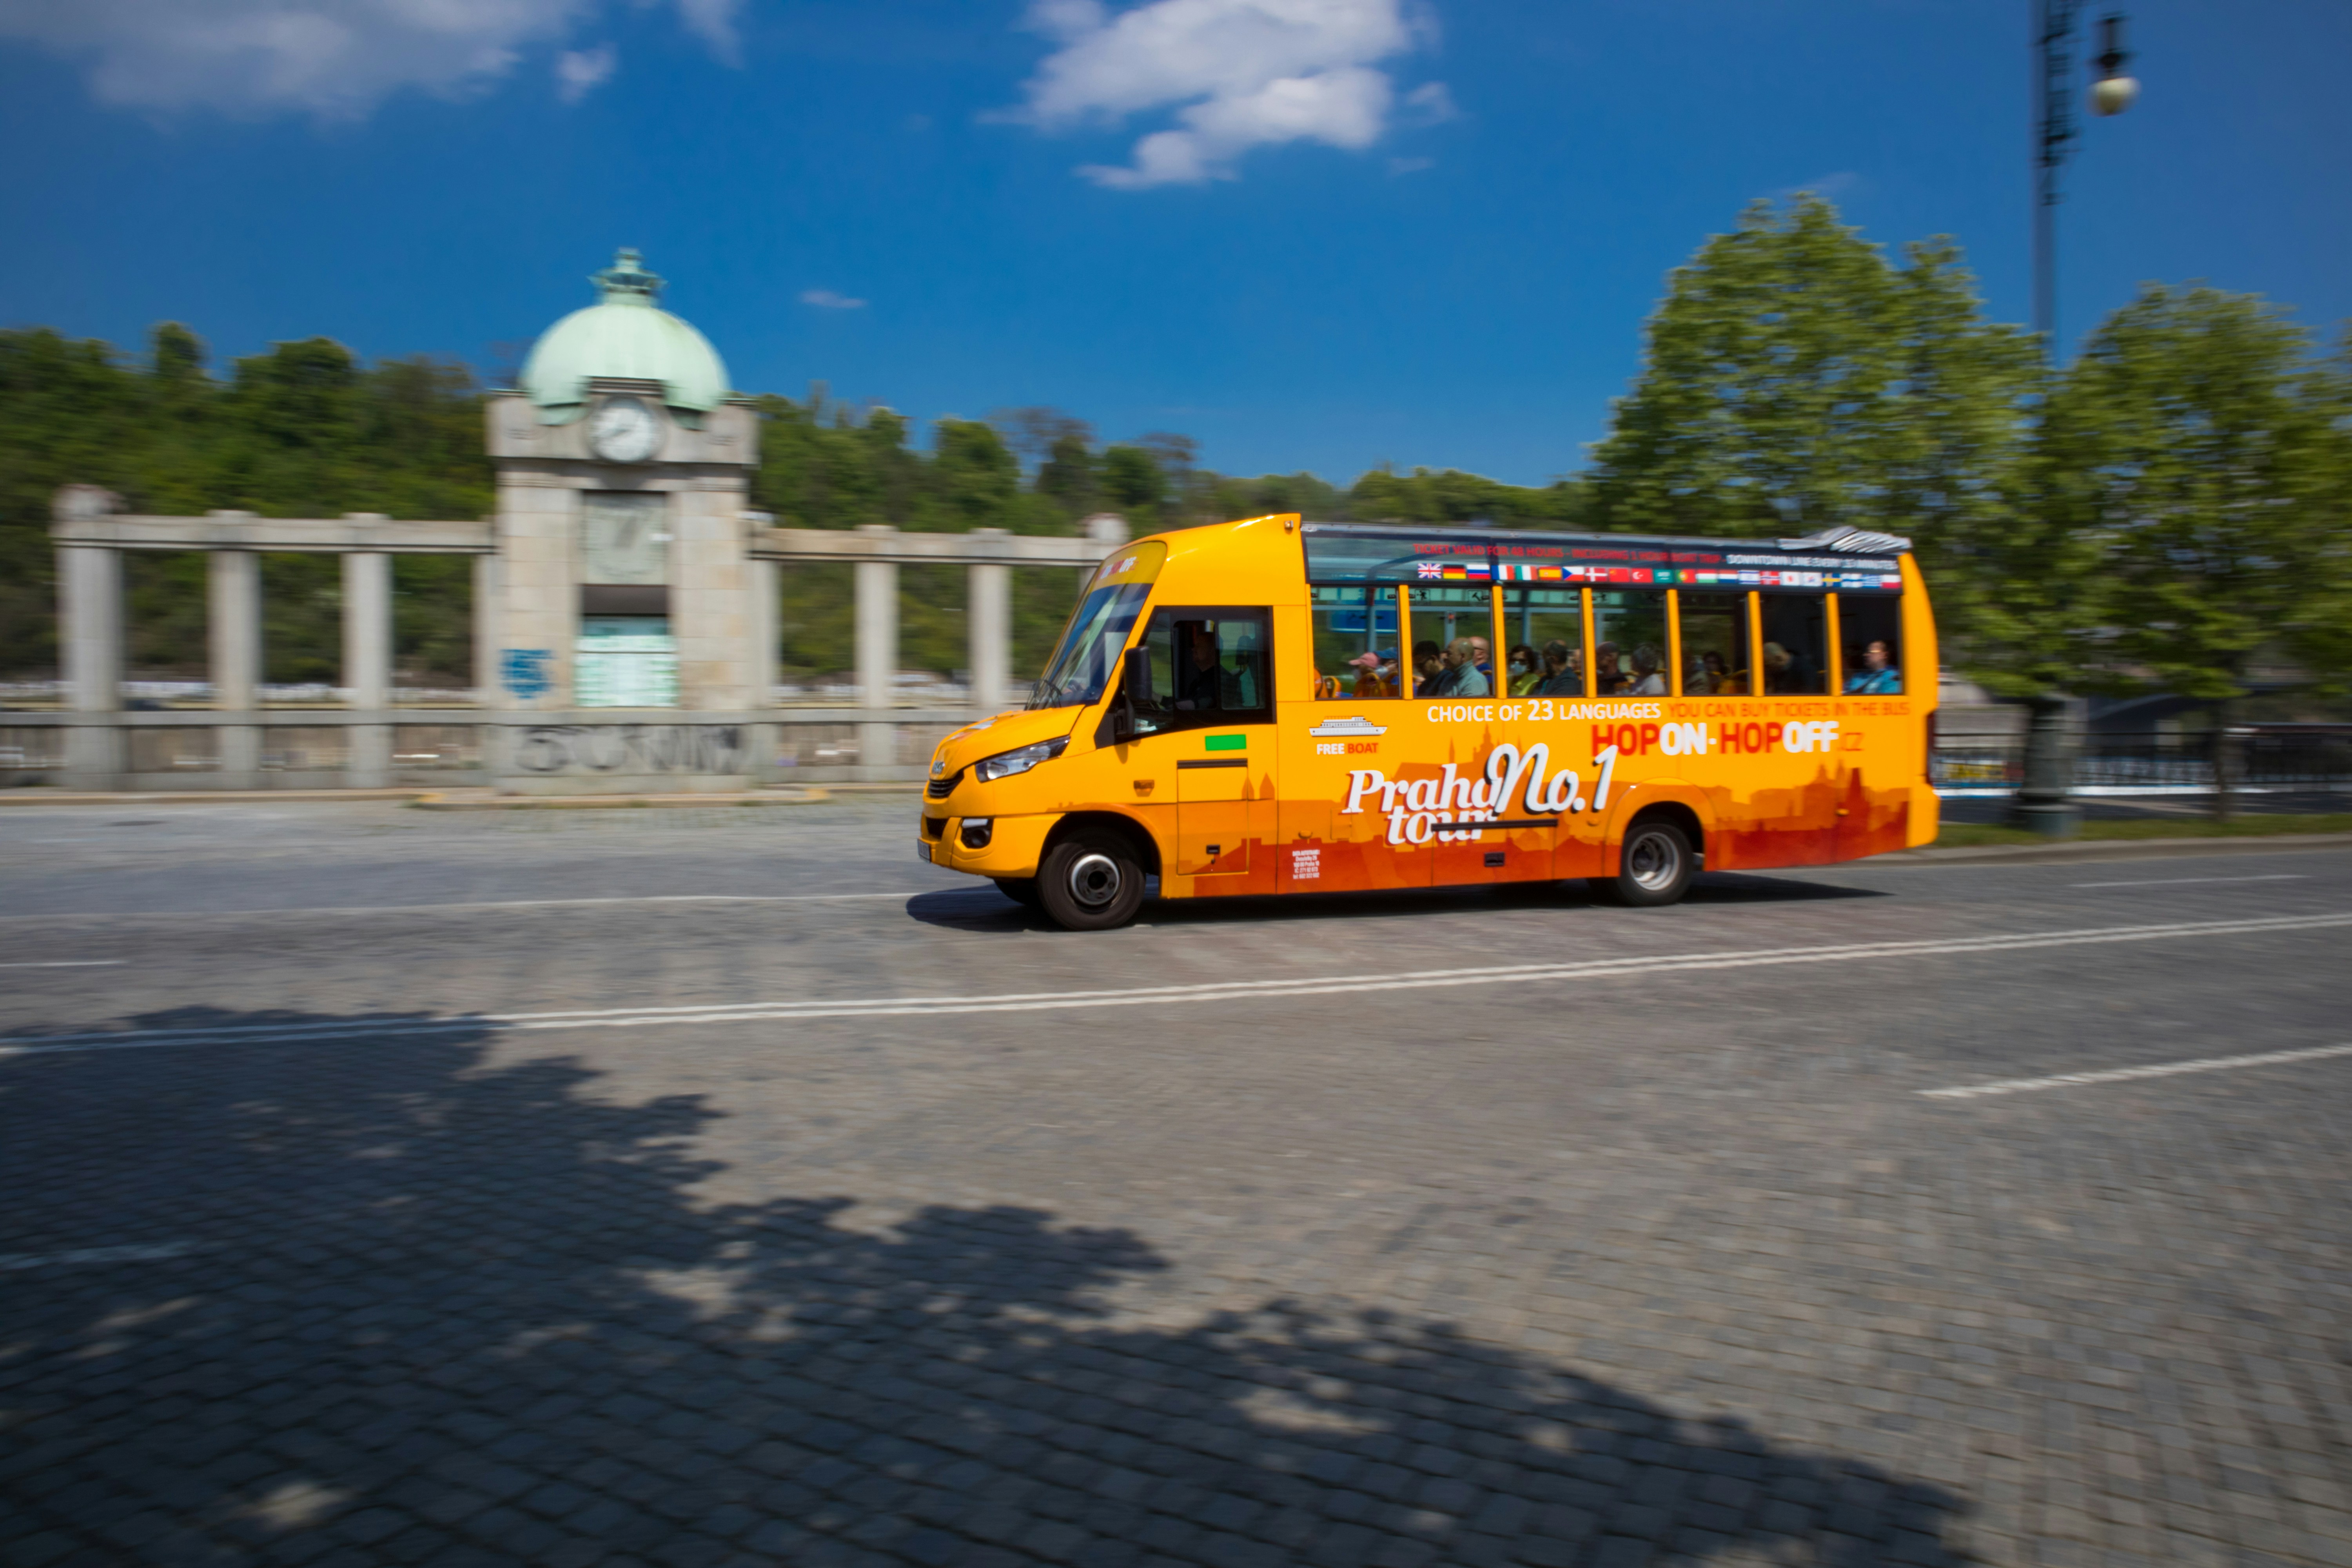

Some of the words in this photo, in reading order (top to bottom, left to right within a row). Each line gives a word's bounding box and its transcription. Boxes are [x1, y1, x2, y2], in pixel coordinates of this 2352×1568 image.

[1413, 543, 1450, 555] TICKET
[1452, 544, 1485, 555] VALID
[1486, 546, 1508, 556] FOR
[1526, 547, 1564, 558] HOURS
[1427, 705, 1494, 722] CHOICE
[1499, 704, 1523, 722] OF
[1527, 699, 1554, 721] 23
[1559, 702, 1662, 720] LANGUAGES
[1668, 703, 1700, 717] YOU
[1705, 703, 1737, 717] CAN
[1741, 703, 1770, 717] BUY
[1775, 702, 1831, 717] TICKETS
[1833, 702, 1849, 716] IN
[1852, 702, 1878, 716] THE
[1883, 702, 1911, 716] BUS
[1316, 743, 1345, 755] FREE
[1347, 742, 1379, 754] BOAT
[1341, 763, 1503, 813] Praha
[1386, 805, 1498, 846] tour
